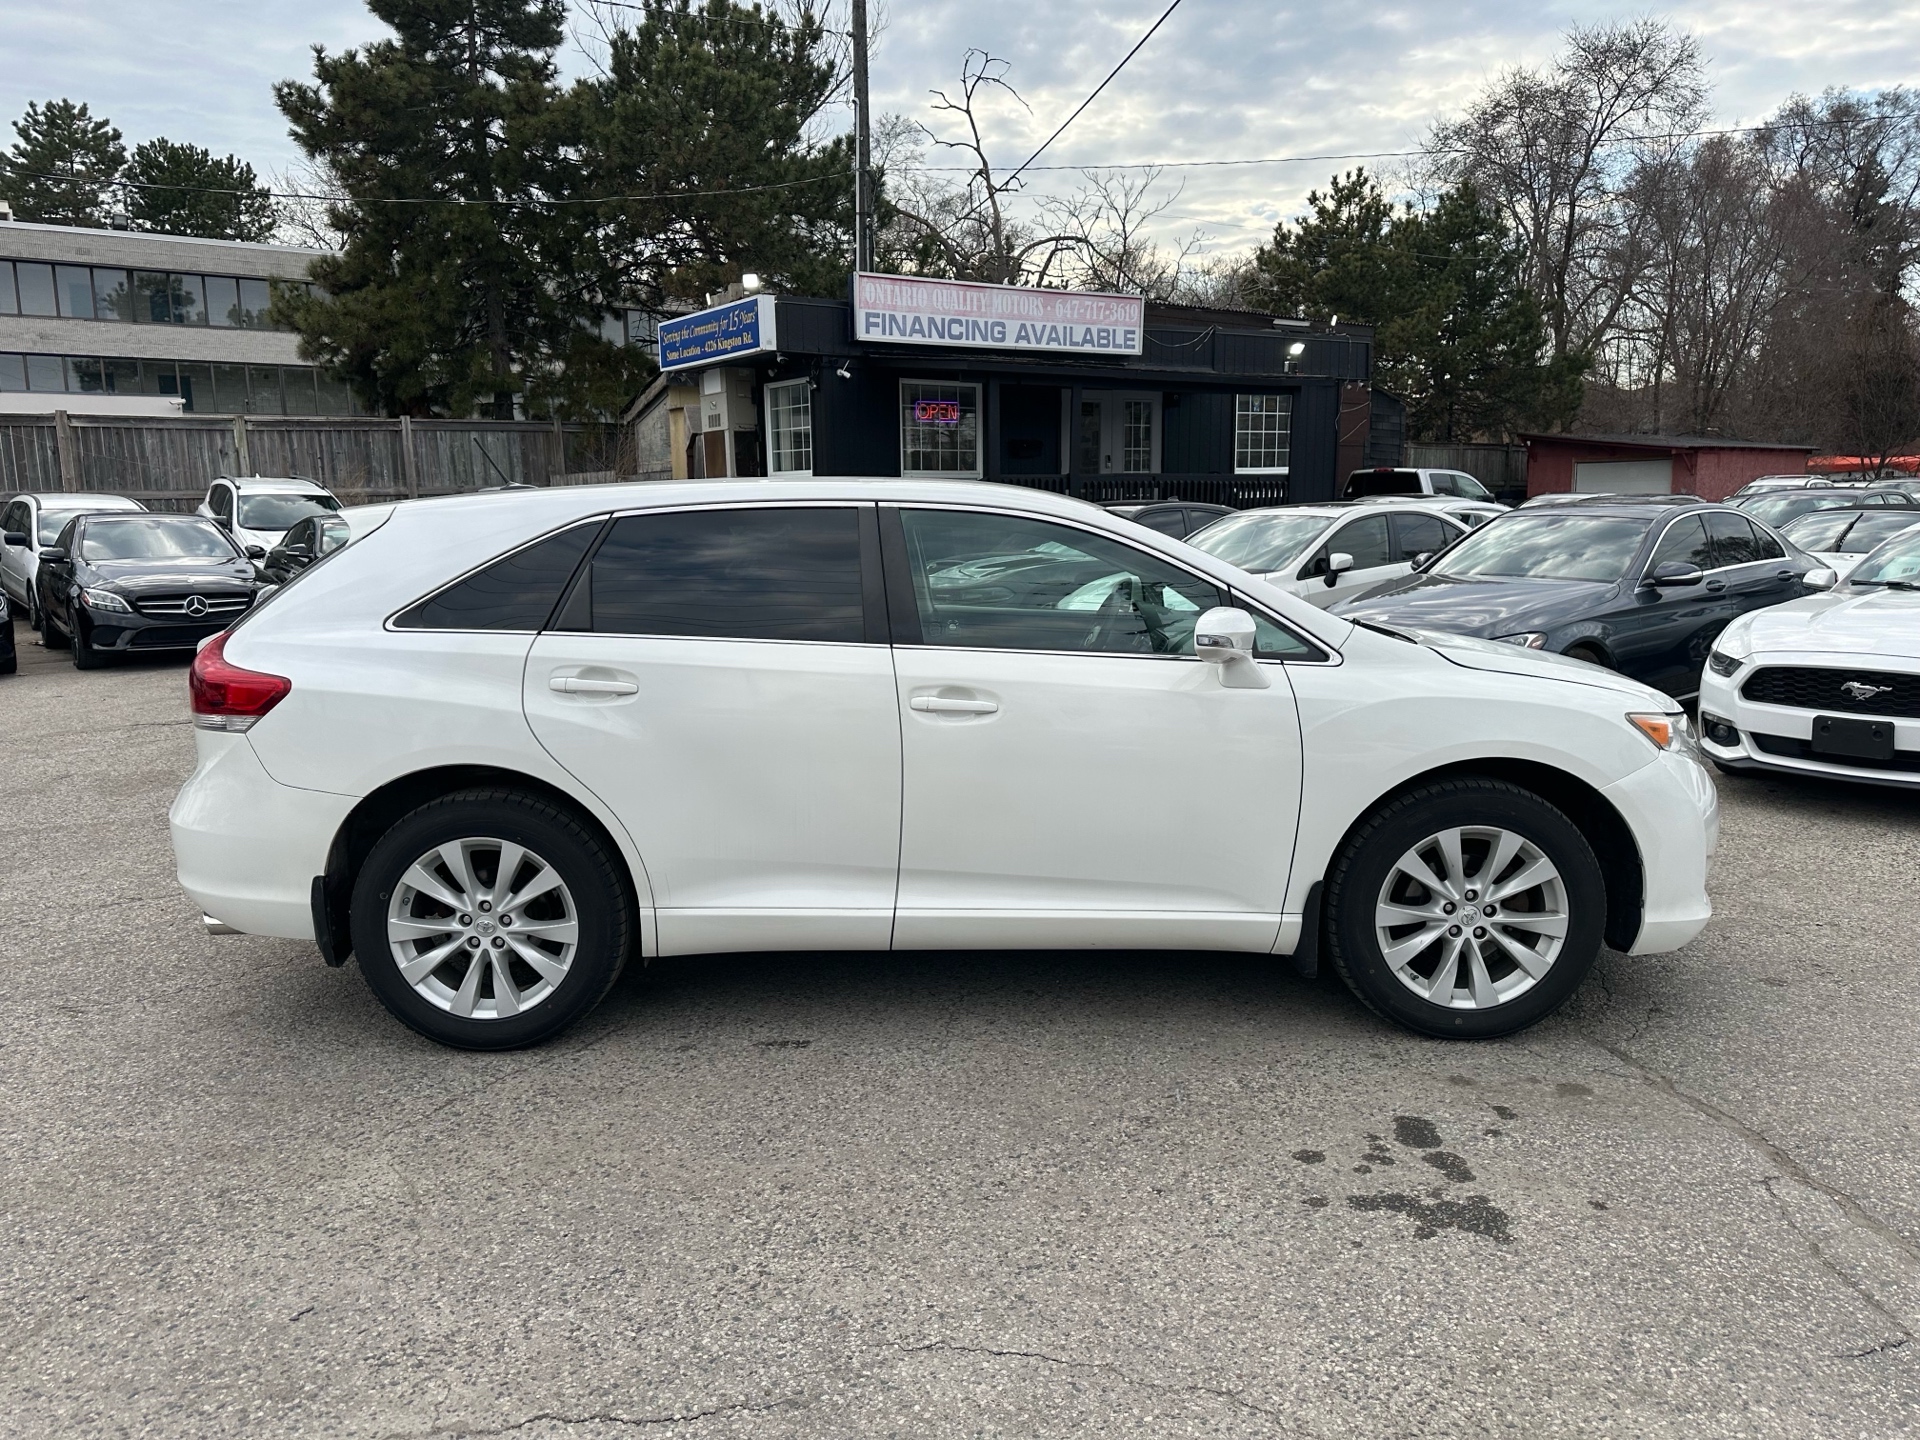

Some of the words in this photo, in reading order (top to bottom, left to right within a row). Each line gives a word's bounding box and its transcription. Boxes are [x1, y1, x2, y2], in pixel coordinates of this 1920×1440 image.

[864, 282, 928, 308] ONTARIO
[932, 288, 989, 312] QUALITY
[992, 293, 1044, 317] MOTORS
[1055, 299, 1139, 322] 647-717-3619
[681, 324, 690, 340] the
[690, 318, 719, 338] Community
[719, 314, 729, 337] for
[728, 308, 740, 331] 15
[864, 311, 1007, 343] FINANCING
[1014, 322, 1136, 350] AVAILABLE
[680, 344, 702, 359] Location
[704, 338, 717, 353] 4226
[717, 336, 742, 351] Kingston
[742, 331, 754, 345] Rd.
[917, 403, 957, 420] OPEN
